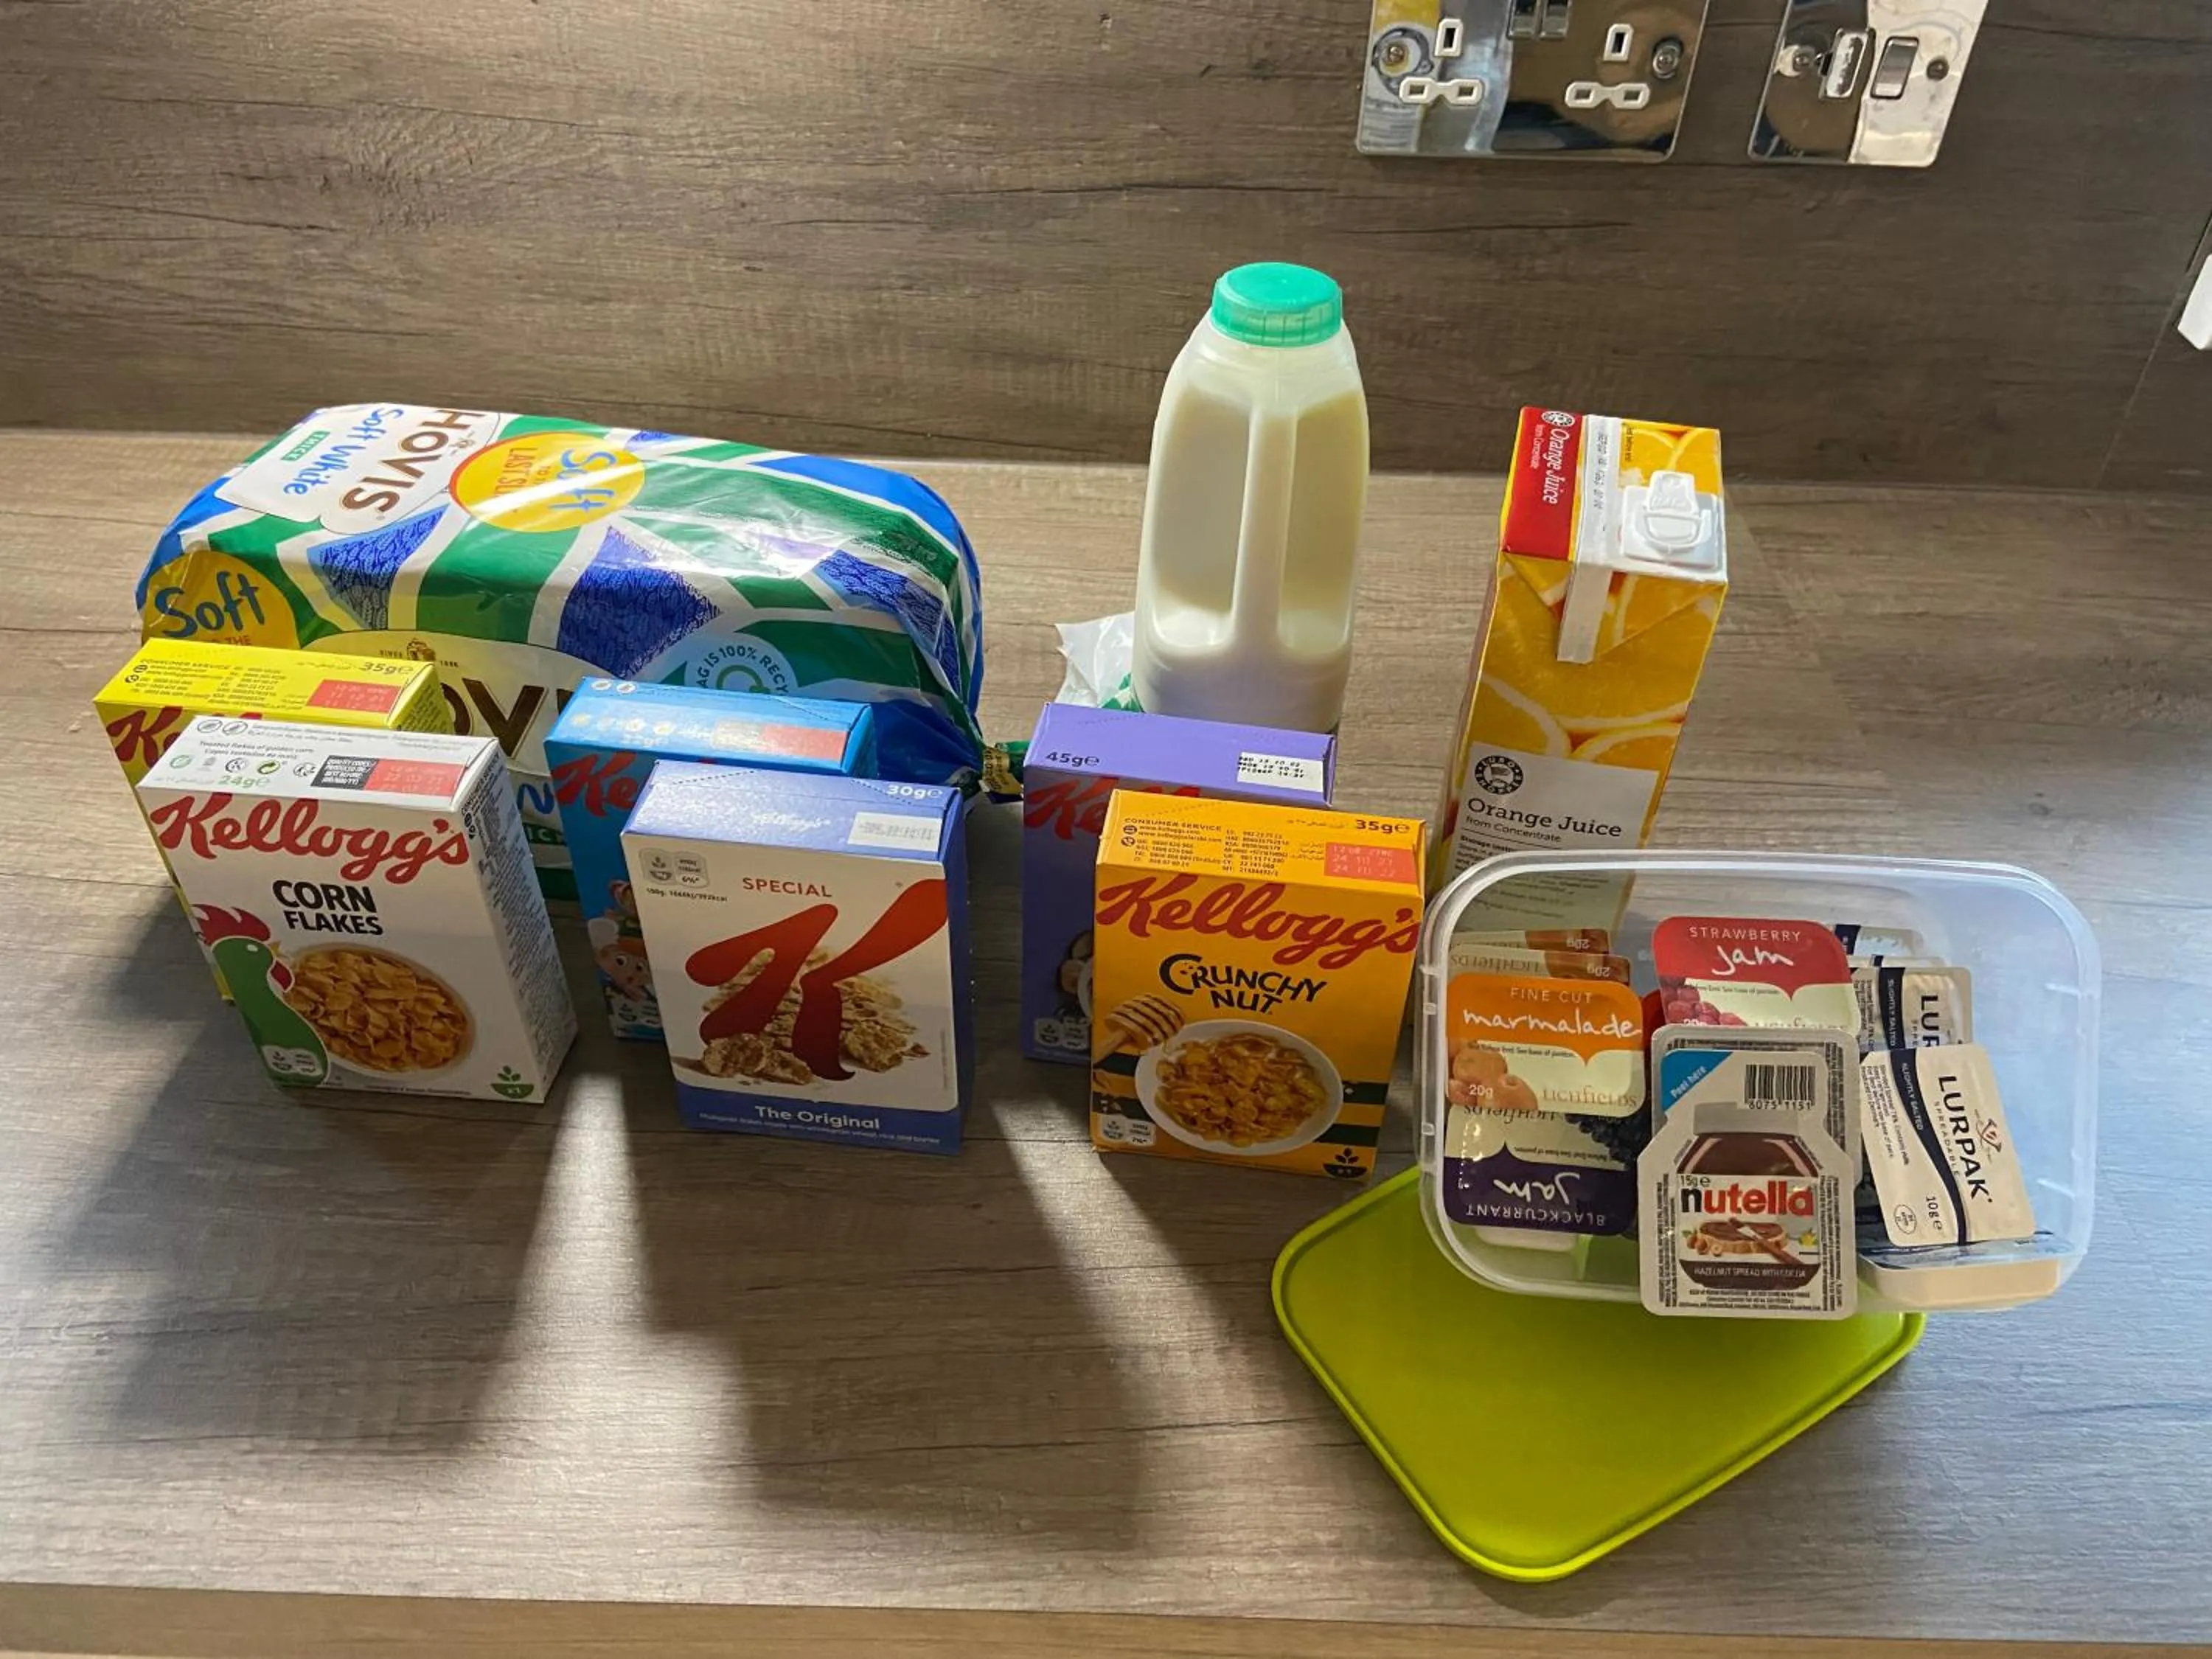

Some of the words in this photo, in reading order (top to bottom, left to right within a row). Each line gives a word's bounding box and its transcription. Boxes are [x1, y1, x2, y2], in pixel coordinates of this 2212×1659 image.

[347, 408, 403, 440] Soft
[342, 410, 484, 512] HOVIS
[506, 448, 538, 476] LAST
[1543, 428, 1570, 470] Orange
[284, 445, 366, 495] White
[1543, 470, 1565, 504] Juice
[155, 571, 265, 638] Soft
[696, 667, 709, 688] AG
[703, 653, 720, 667] IS
[719, 645, 757, 660] 100%
[1124, 818, 1178, 826] CONSUMER
[1182, 821, 1222, 831] SERVICE
[1465, 816, 1491, 829] from
[1495, 822, 1562, 843] Concentrate
[1467, 798, 1552, 828] Orange
[1558, 816, 1622, 837] Juice
[150, 793, 469, 883] Kellogg's
[272, 880, 377, 913] CORN
[742, 877, 832, 898] SPECIAL
[284, 910, 383, 936] FLAKES
[1095, 874, 1421, 969] Kellogg's
[1689, 927, 1801, 942] STRAWBERRY
[685, 879, 948, 1081] K
[1158, 953, 1327, 1004] CRUNCHY
[1211, 990, 1283, 1014] NUT
[1511, 987, 1550, 1002] FINE
[1559, 991, 1593, 1004] CUT
[1463, 1008, 1642, 1038] marmalade
[1469, 1085, 1494, 1098] 20g
[755, 1106, 791, 1120] The
[797, 1110, 880, 1129] Original
[1933, 1100, 1961, 1177] SPREADABLE
[1938, 1075, 1992, 1200] LURPAK
[1466, 1203, 1604, 1226] BLACKCURRANT
[1681, 1181, 1814, 1215] nutella
[1694, 1267, 1731, 1276] HAZELNUT
[1733, 1267, 1760, 1276] SPREAD
